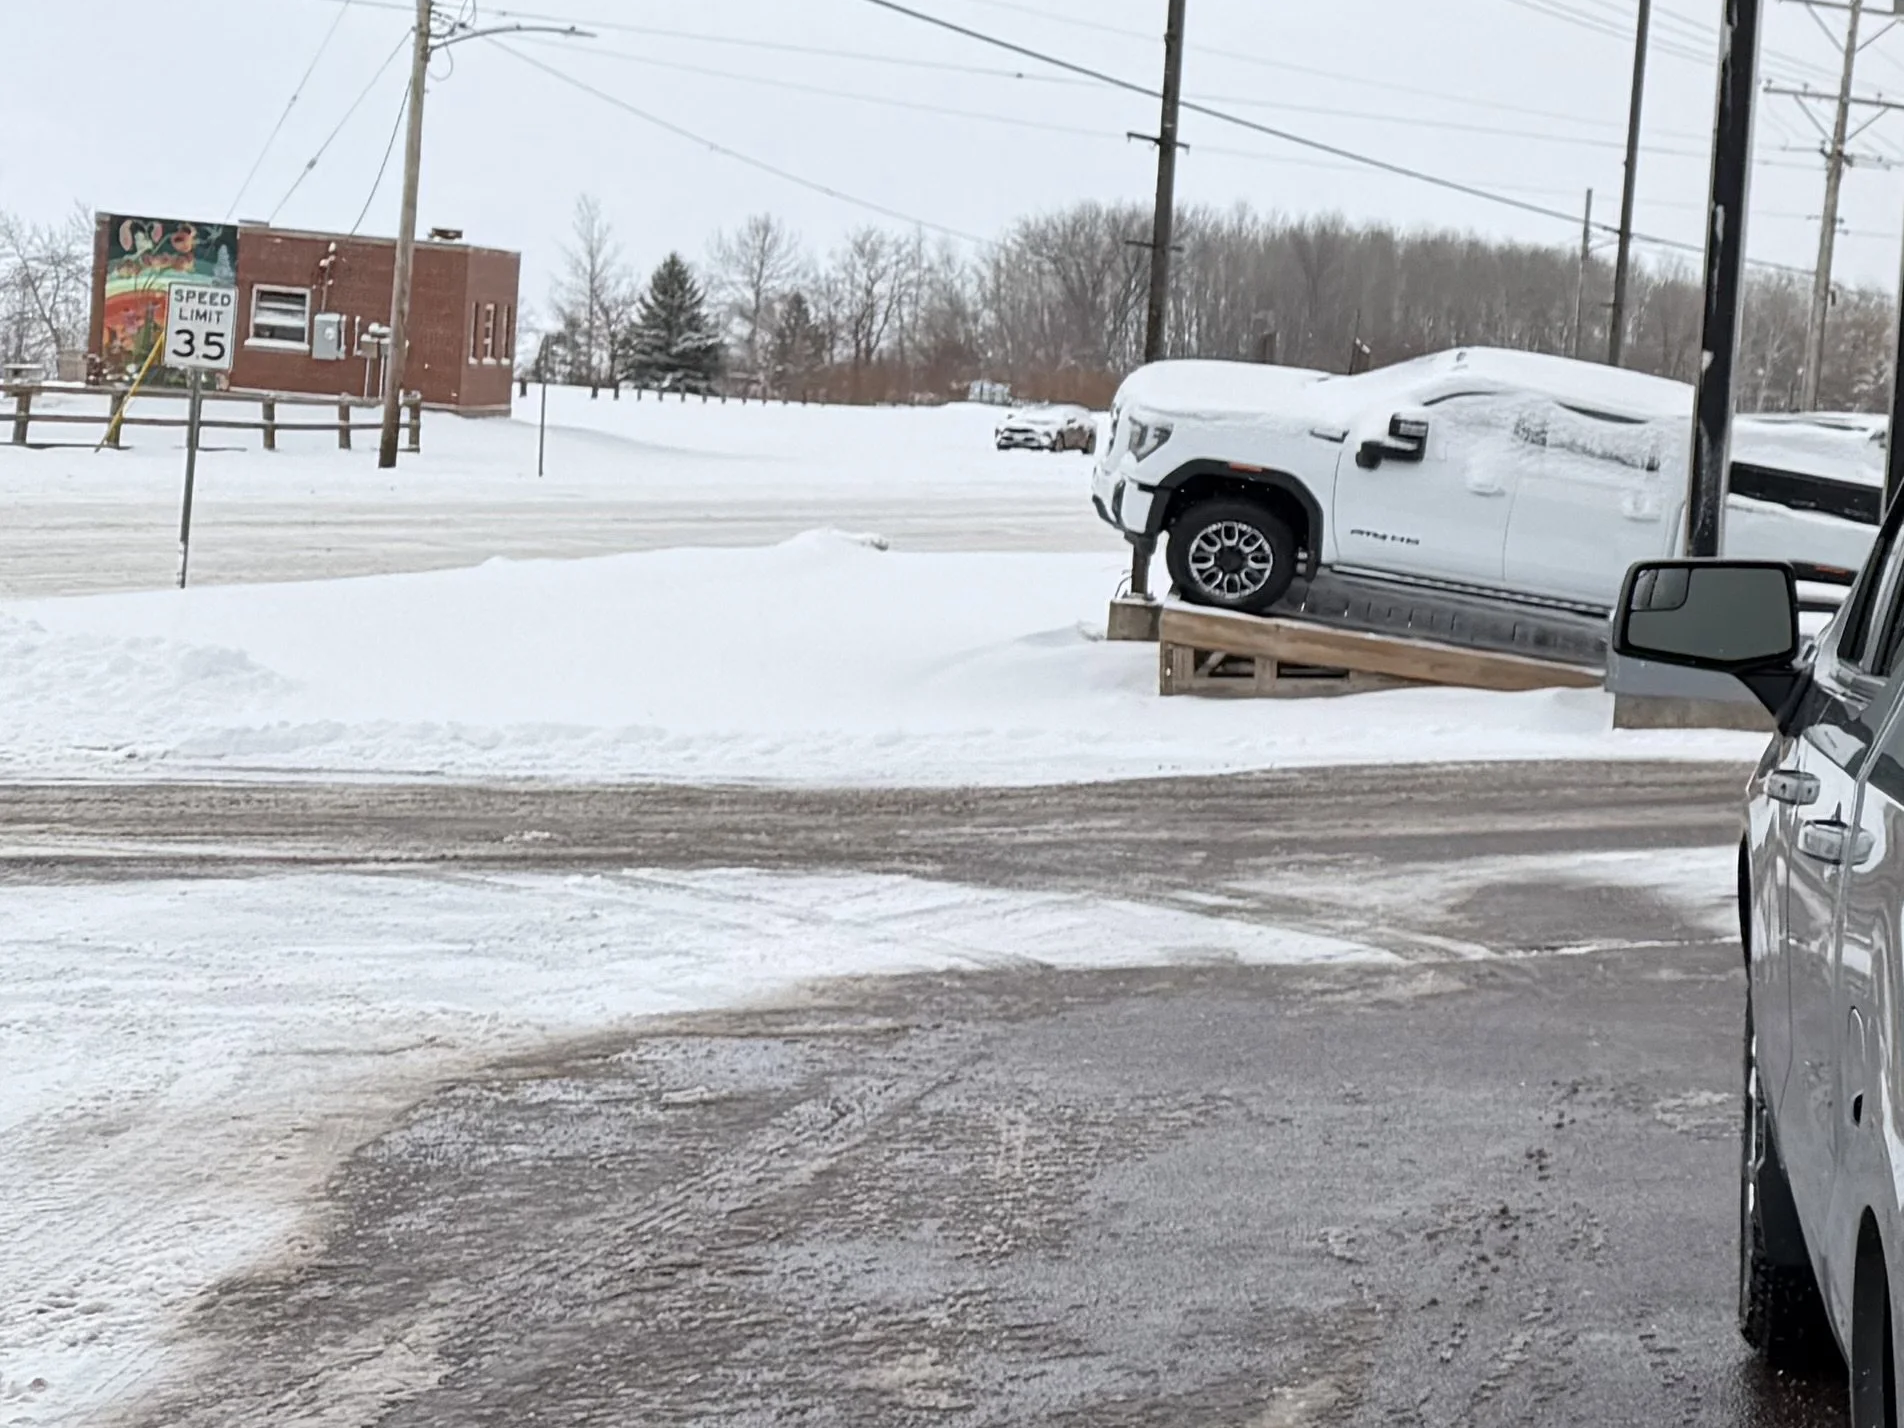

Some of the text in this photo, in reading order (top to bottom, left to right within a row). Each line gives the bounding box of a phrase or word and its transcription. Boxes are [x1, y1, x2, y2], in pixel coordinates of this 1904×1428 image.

[174, 289, 231, 307] SPEED
[178, 308, 224, 324] LIMIT
[172, 329, 225, 361] 35
